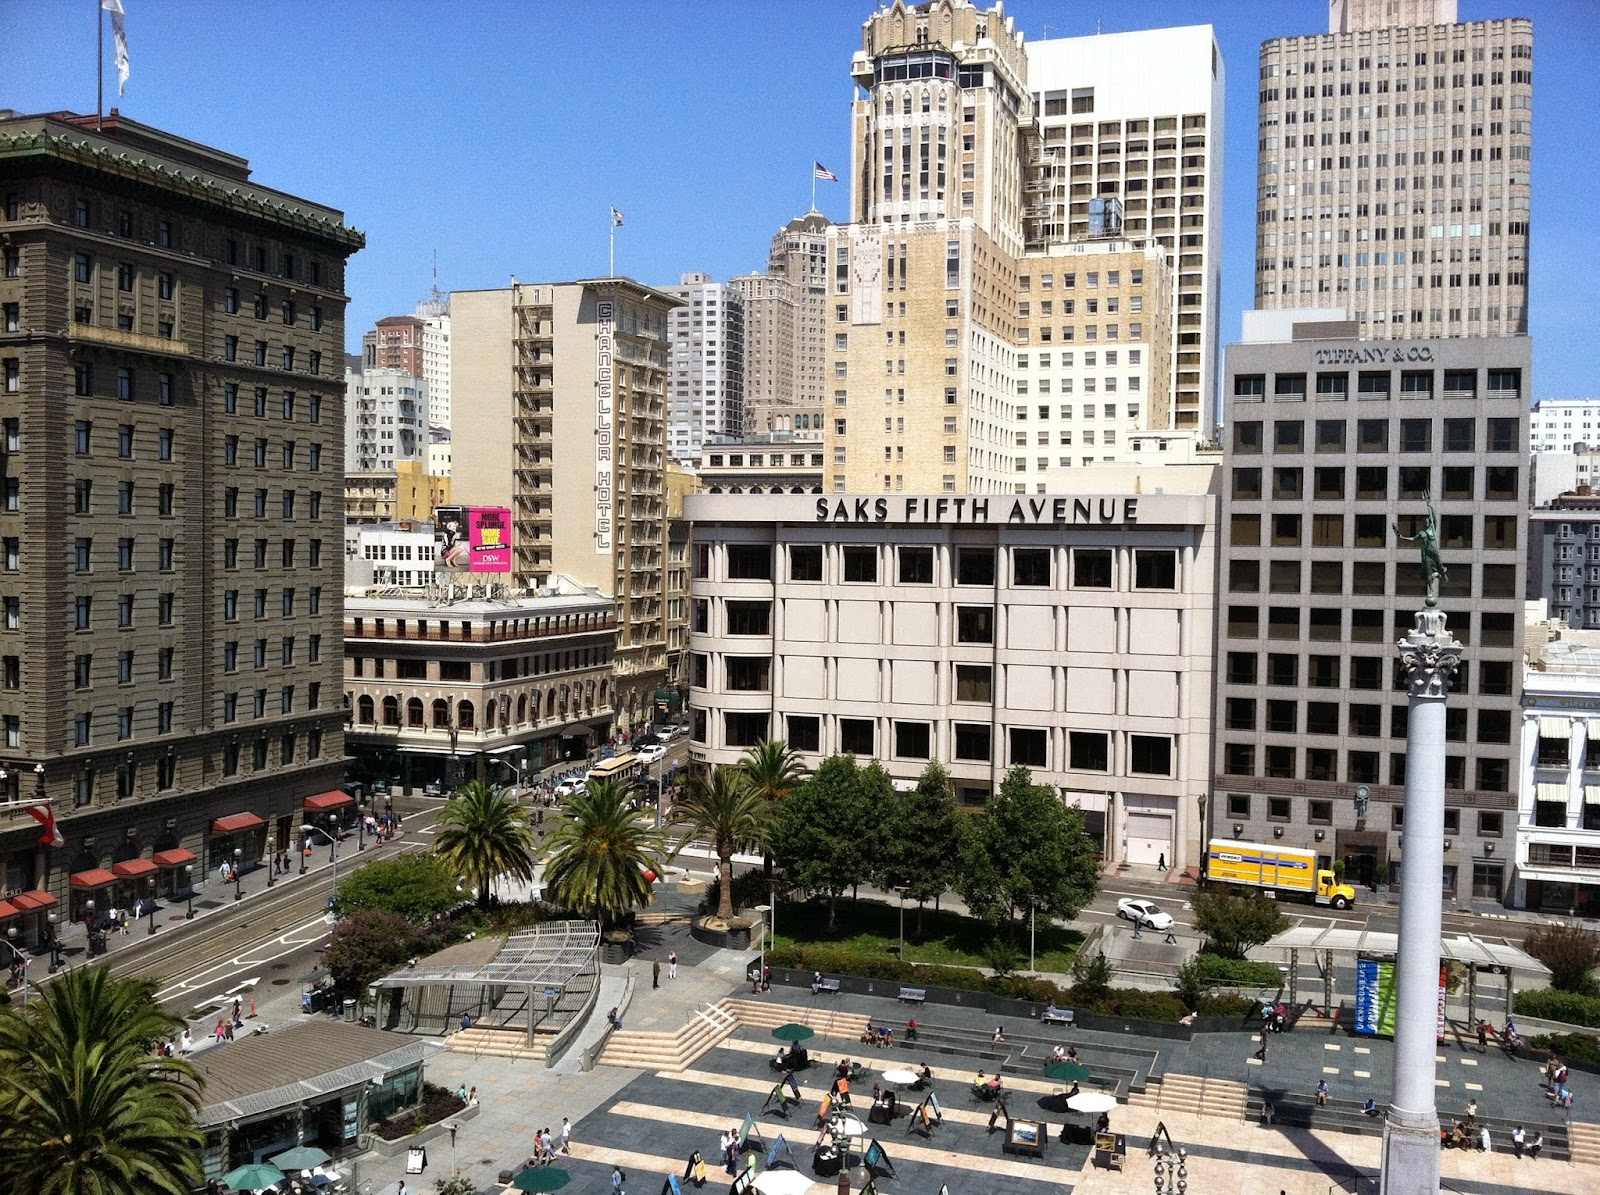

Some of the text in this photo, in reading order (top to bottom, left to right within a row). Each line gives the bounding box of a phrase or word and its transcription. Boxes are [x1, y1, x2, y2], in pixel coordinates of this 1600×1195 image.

[1316, 348, 1390, 364] TIFFANY
[1392, 347, 1405, 363] &
[597, 303, 612, 548] CHANCELLOR HOTEL
[481, 513, 500, 521] MORE
[816, 498, 1138, 524] SAKS FIFTH AVENUE
[481, 529, 501, 537] MORE
